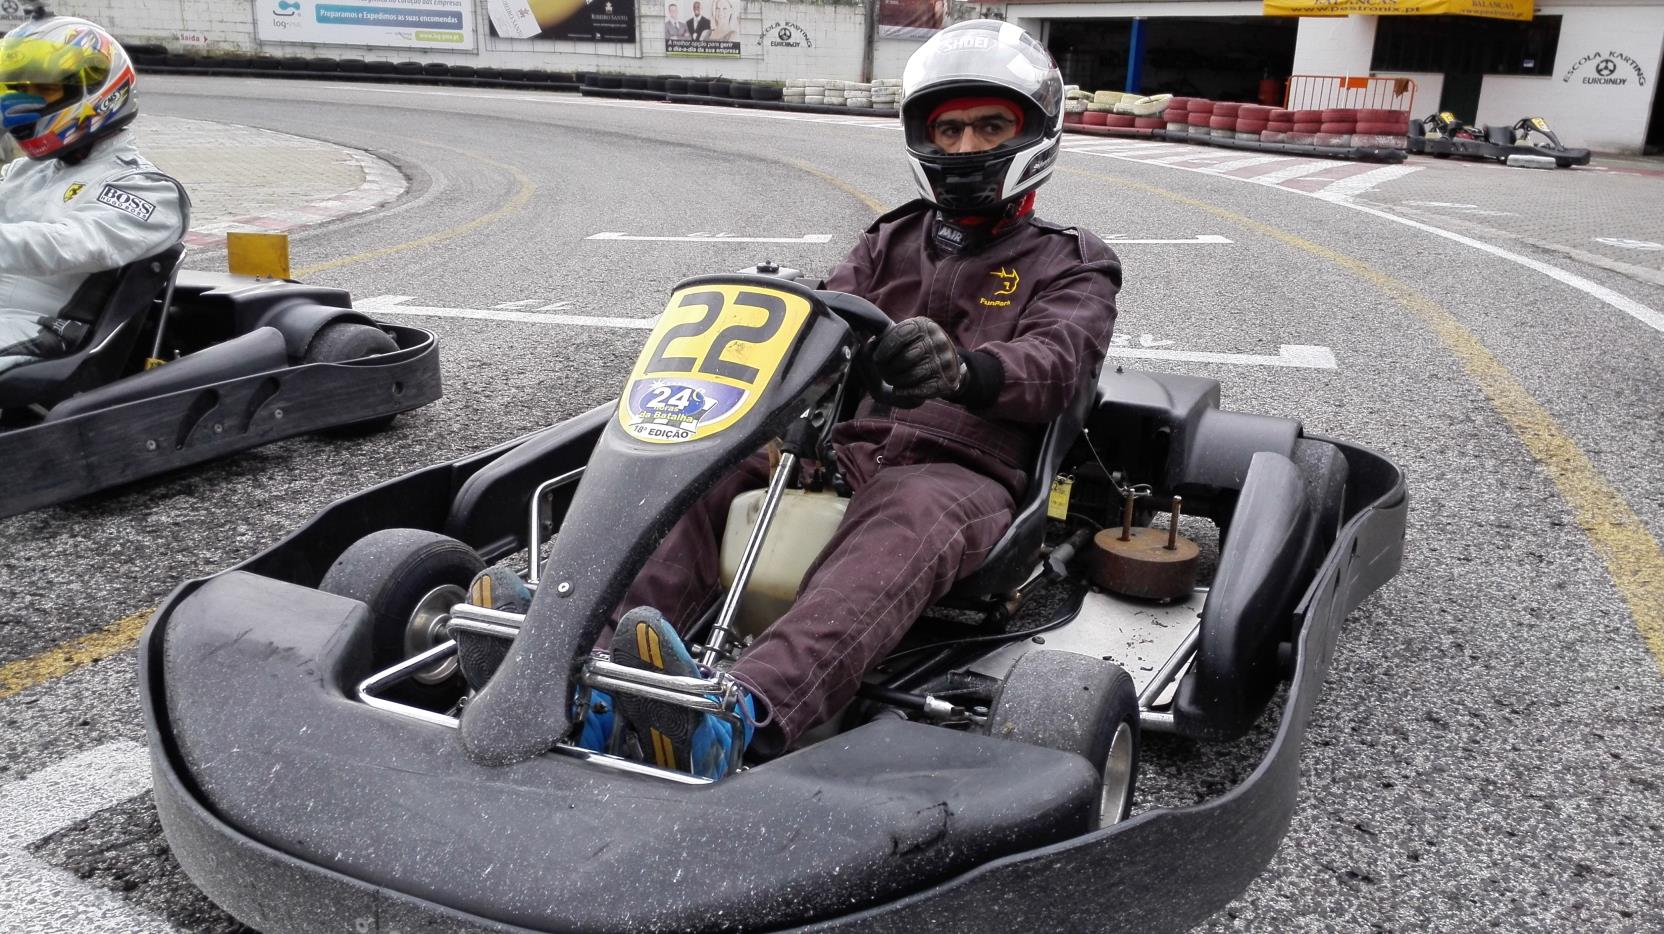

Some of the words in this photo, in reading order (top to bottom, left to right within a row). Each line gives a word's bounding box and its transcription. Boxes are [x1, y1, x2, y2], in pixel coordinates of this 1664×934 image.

[320, 10, 358, 18] Preparamos
[363, 12, 397, 21] Expedimos
[944, 37, 989, 49] SHOEI
[1563, 52, 1601, 83] ESCOLA
[1609, 51, 1646, 86] KARTING
[1582, 77, 1627, 86] EUROINDY
[101, 195, 123, 207] HUGO
[103, 186, 151, 214] BOSS
[644, 291, 787, 385] 22
[646, 386, 692, 410] 24
[654, 404, 680, 412] horas
[653, 411, 694, 423] Batalha
[648, 427, 689, 439] EDIÇÃO
